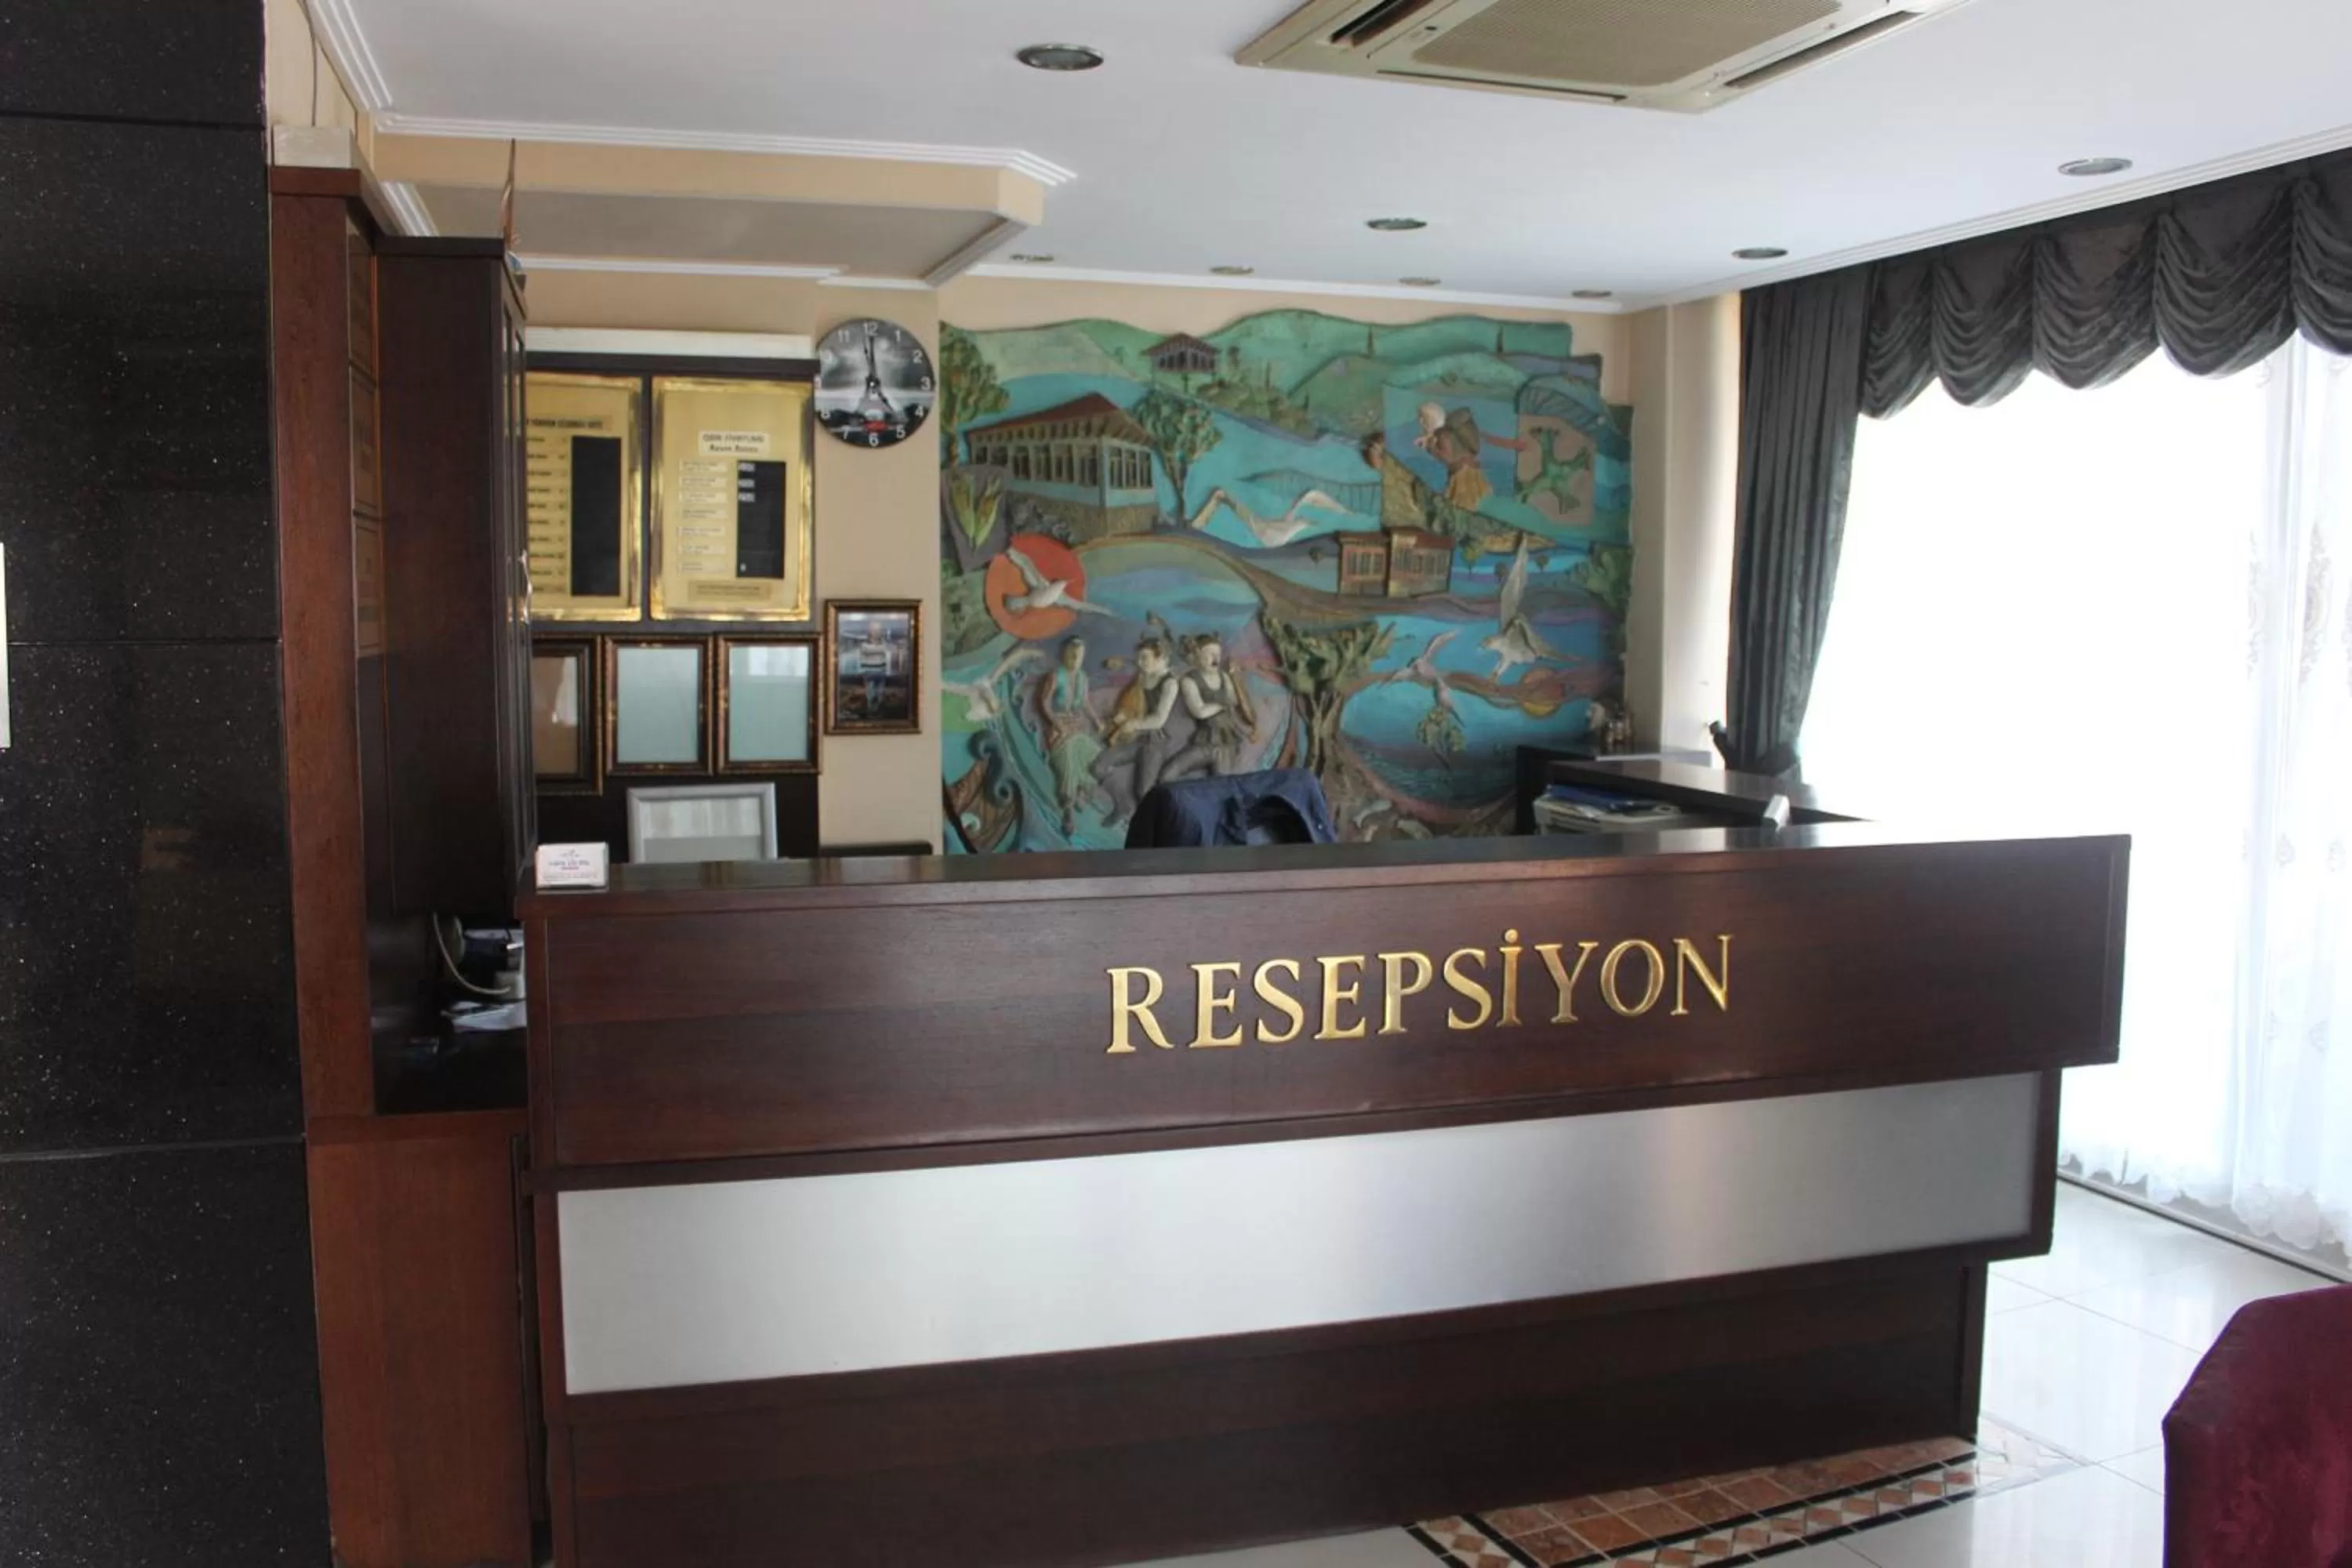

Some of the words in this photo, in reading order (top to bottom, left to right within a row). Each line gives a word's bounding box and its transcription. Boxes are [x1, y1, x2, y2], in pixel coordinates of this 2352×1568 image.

[837, 328, 851, 343] 11
[863, 322, 878, 336] 12
[895, 329, 901, 342] 1
[913, 350, 923, 364] 2
[920, 376, 931, 390] 3
[915, 405, 924, 418] 4
[843, 426, 850, 440] 7
[896, 423, 906, 438] 5
[869, 433, 879, 447] 6
[1105, 928, 1735, 1054] RESEPSİYON
